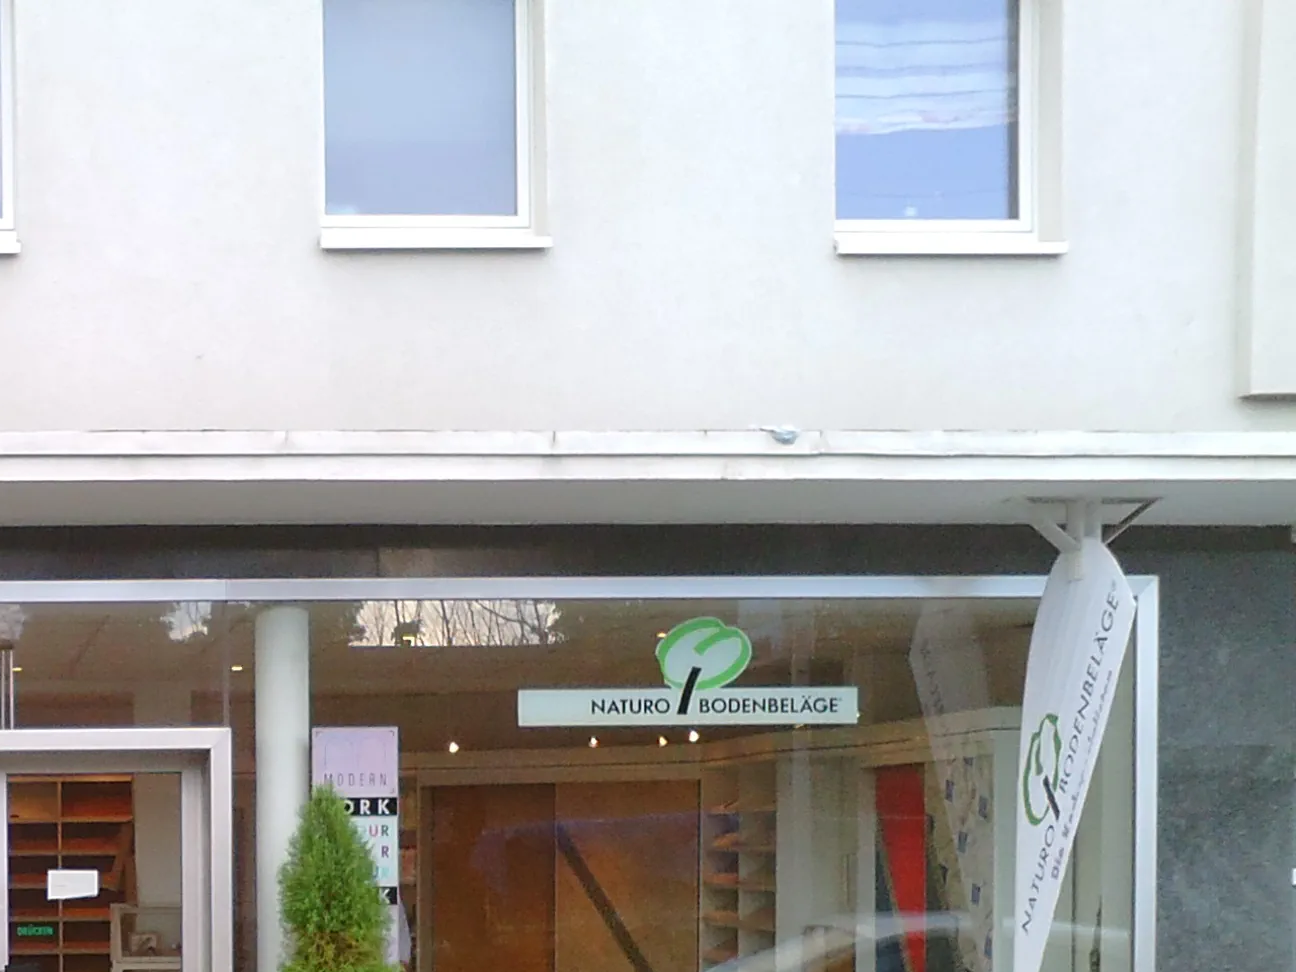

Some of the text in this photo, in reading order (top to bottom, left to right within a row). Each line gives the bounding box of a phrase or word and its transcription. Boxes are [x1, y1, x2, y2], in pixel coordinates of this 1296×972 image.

[591, 694, 839, 715] NATURO BODENBELÄGE
[1021, 590, 1120, 935] NATURO BODENBELÄGE
[323, 772, 388, 788] MODERN
[342, 799, 390, 816] ORK
